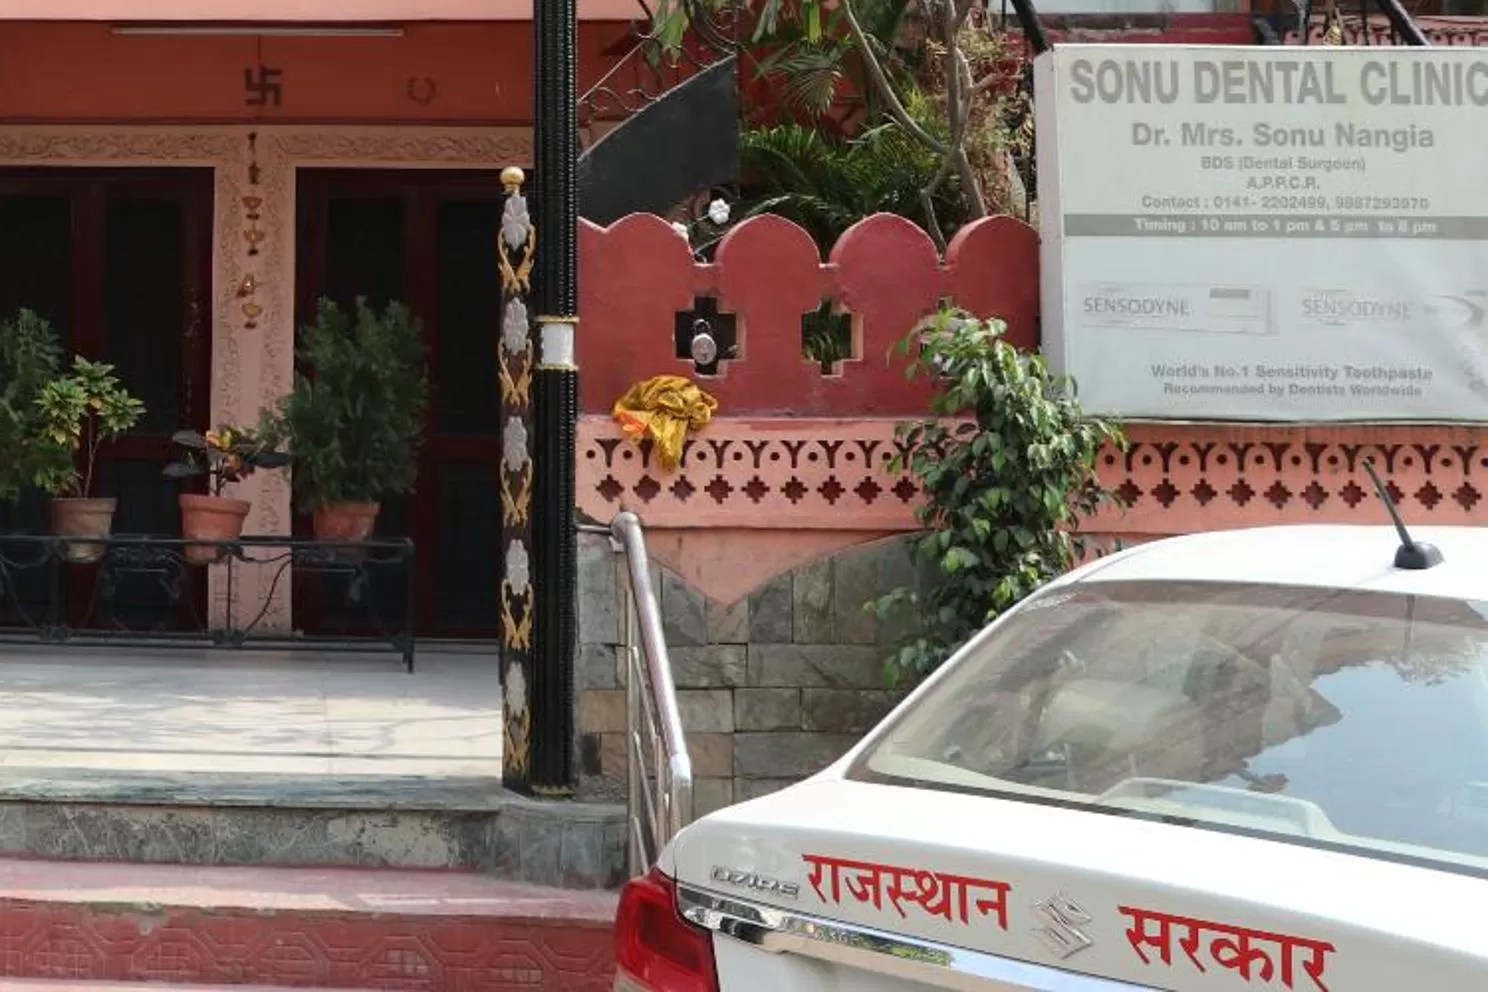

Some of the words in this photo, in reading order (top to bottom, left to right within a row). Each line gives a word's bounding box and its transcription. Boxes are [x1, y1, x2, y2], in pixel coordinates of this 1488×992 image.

[1070, 59, 1179, 104] SONU
[1193, 60, 1347, 104] DENTAL
[1360, 61, 1488, 106] CLINIC
[1132, 123, 1170, 147] Dr.
[1182, 123, 1243, 148] Mrs.
[1253, 123, 1324, 148] Sonu
[1335, 124, 1435, 153] Nangia
[1201, 156, 1234, 170] BDS
[1239, 156, 1293, 172] (Dental
[1142, 195, 1200, 209] Contact
[1133, 217, 1188, 233] Timing
[1201, 219, 1220, 231] 10
[1224, 220, 1247, 231] am
[1252, 219, 1268, 231] to
[1273, 220, 1281, 231] 1
[1286, 221, 1310, 233] pm
[1344, 220, 1369, 234] pm
[1412, 221, 1438, 234] pm
[1151, 364, 1210, 378] World's
[1255, 364, 1338, 381] Sensitivity
[1344, 365, 1433, 381] Toothpaste
[1164, 383, 1264, 395] Recommended
[1269, 384, 1284, 397] by
[1350, 384, 1422, 397] Worldwide
[802, 854, 1011, 930] राजस्थान
[1118, 905, 1336, 992] सरकार
